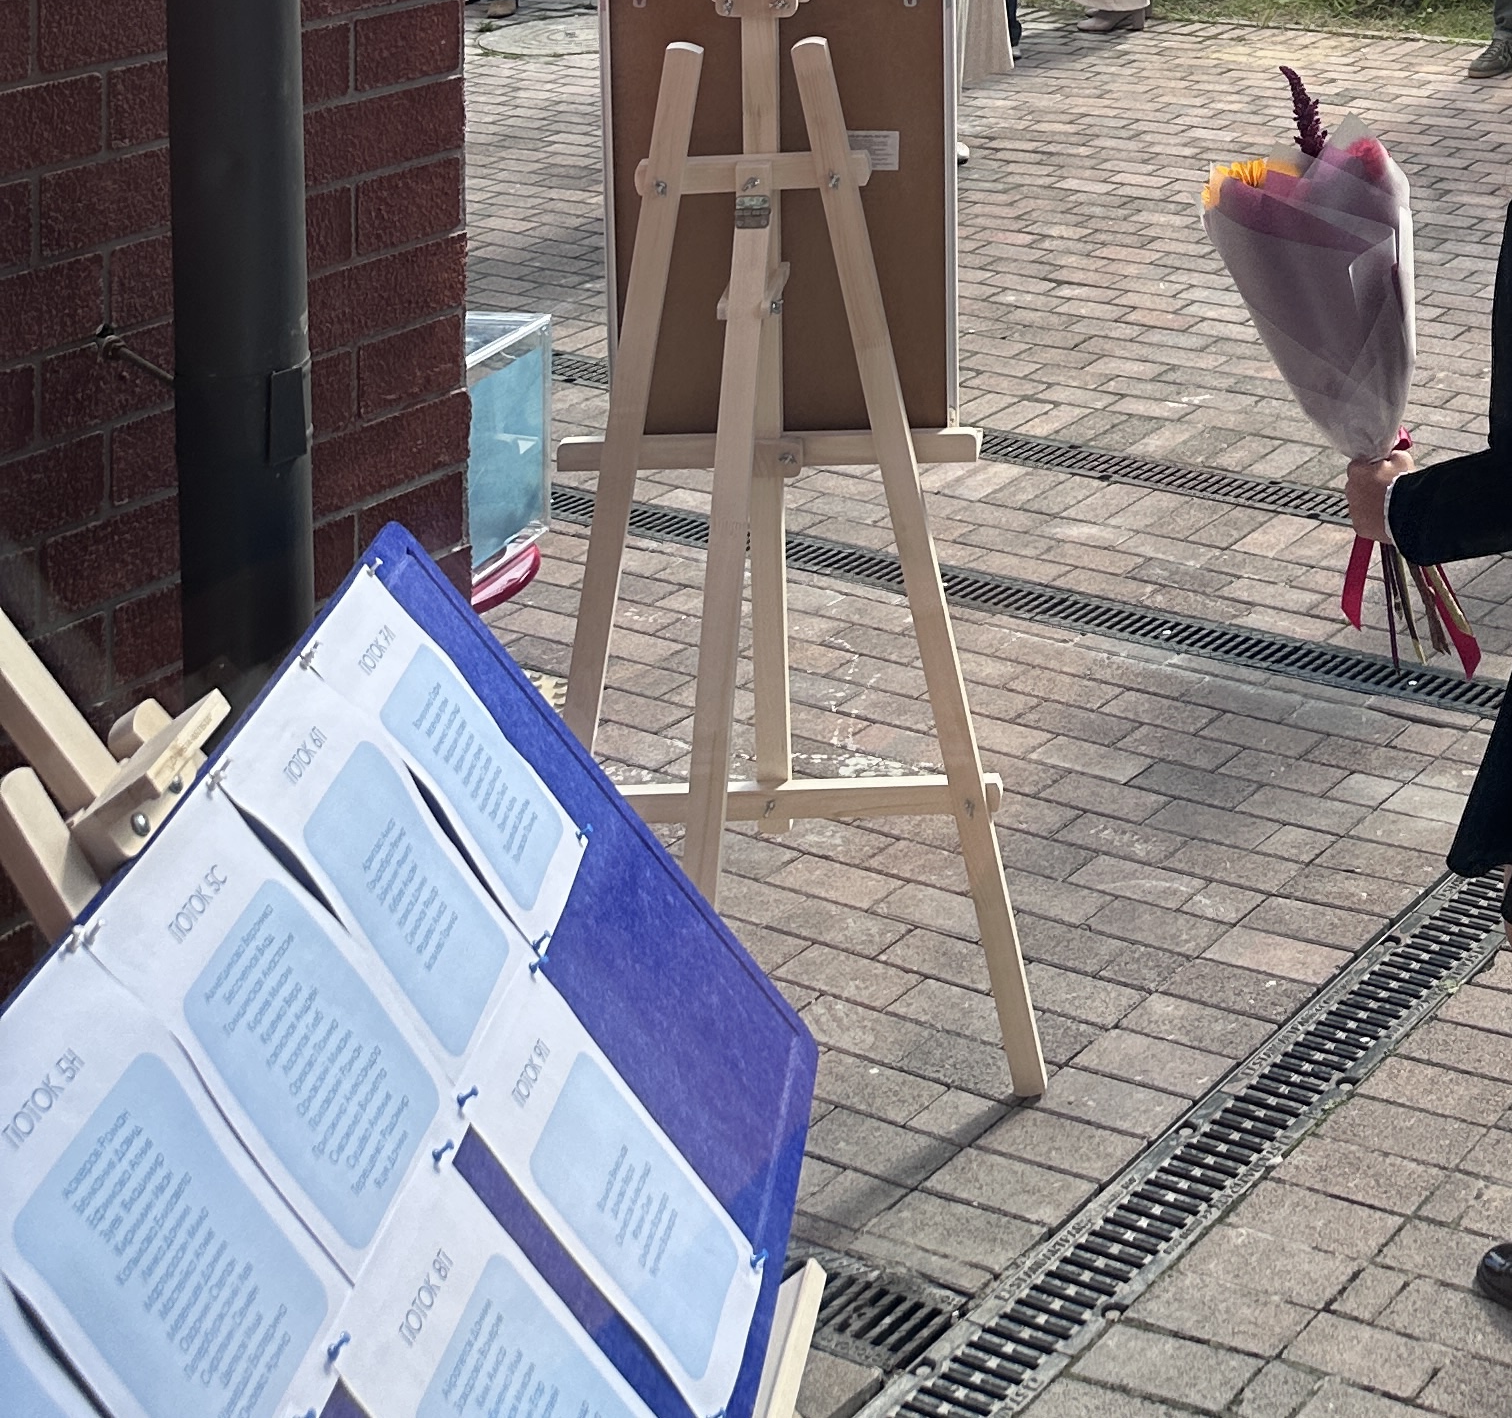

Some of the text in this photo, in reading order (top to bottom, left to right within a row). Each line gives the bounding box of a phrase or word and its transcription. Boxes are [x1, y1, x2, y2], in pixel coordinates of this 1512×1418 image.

[358, 636, 387, 676] ПОТОК
[283, 740, 317, 785] ПОТОК
[168, 884, 214, 944] ПОТОК
[511, 1054, 542, 1108] ПОТОК
[1, 1073, 64, 1149] ПОТОК
[398, 1272, 441, 1348] ПОТОК
